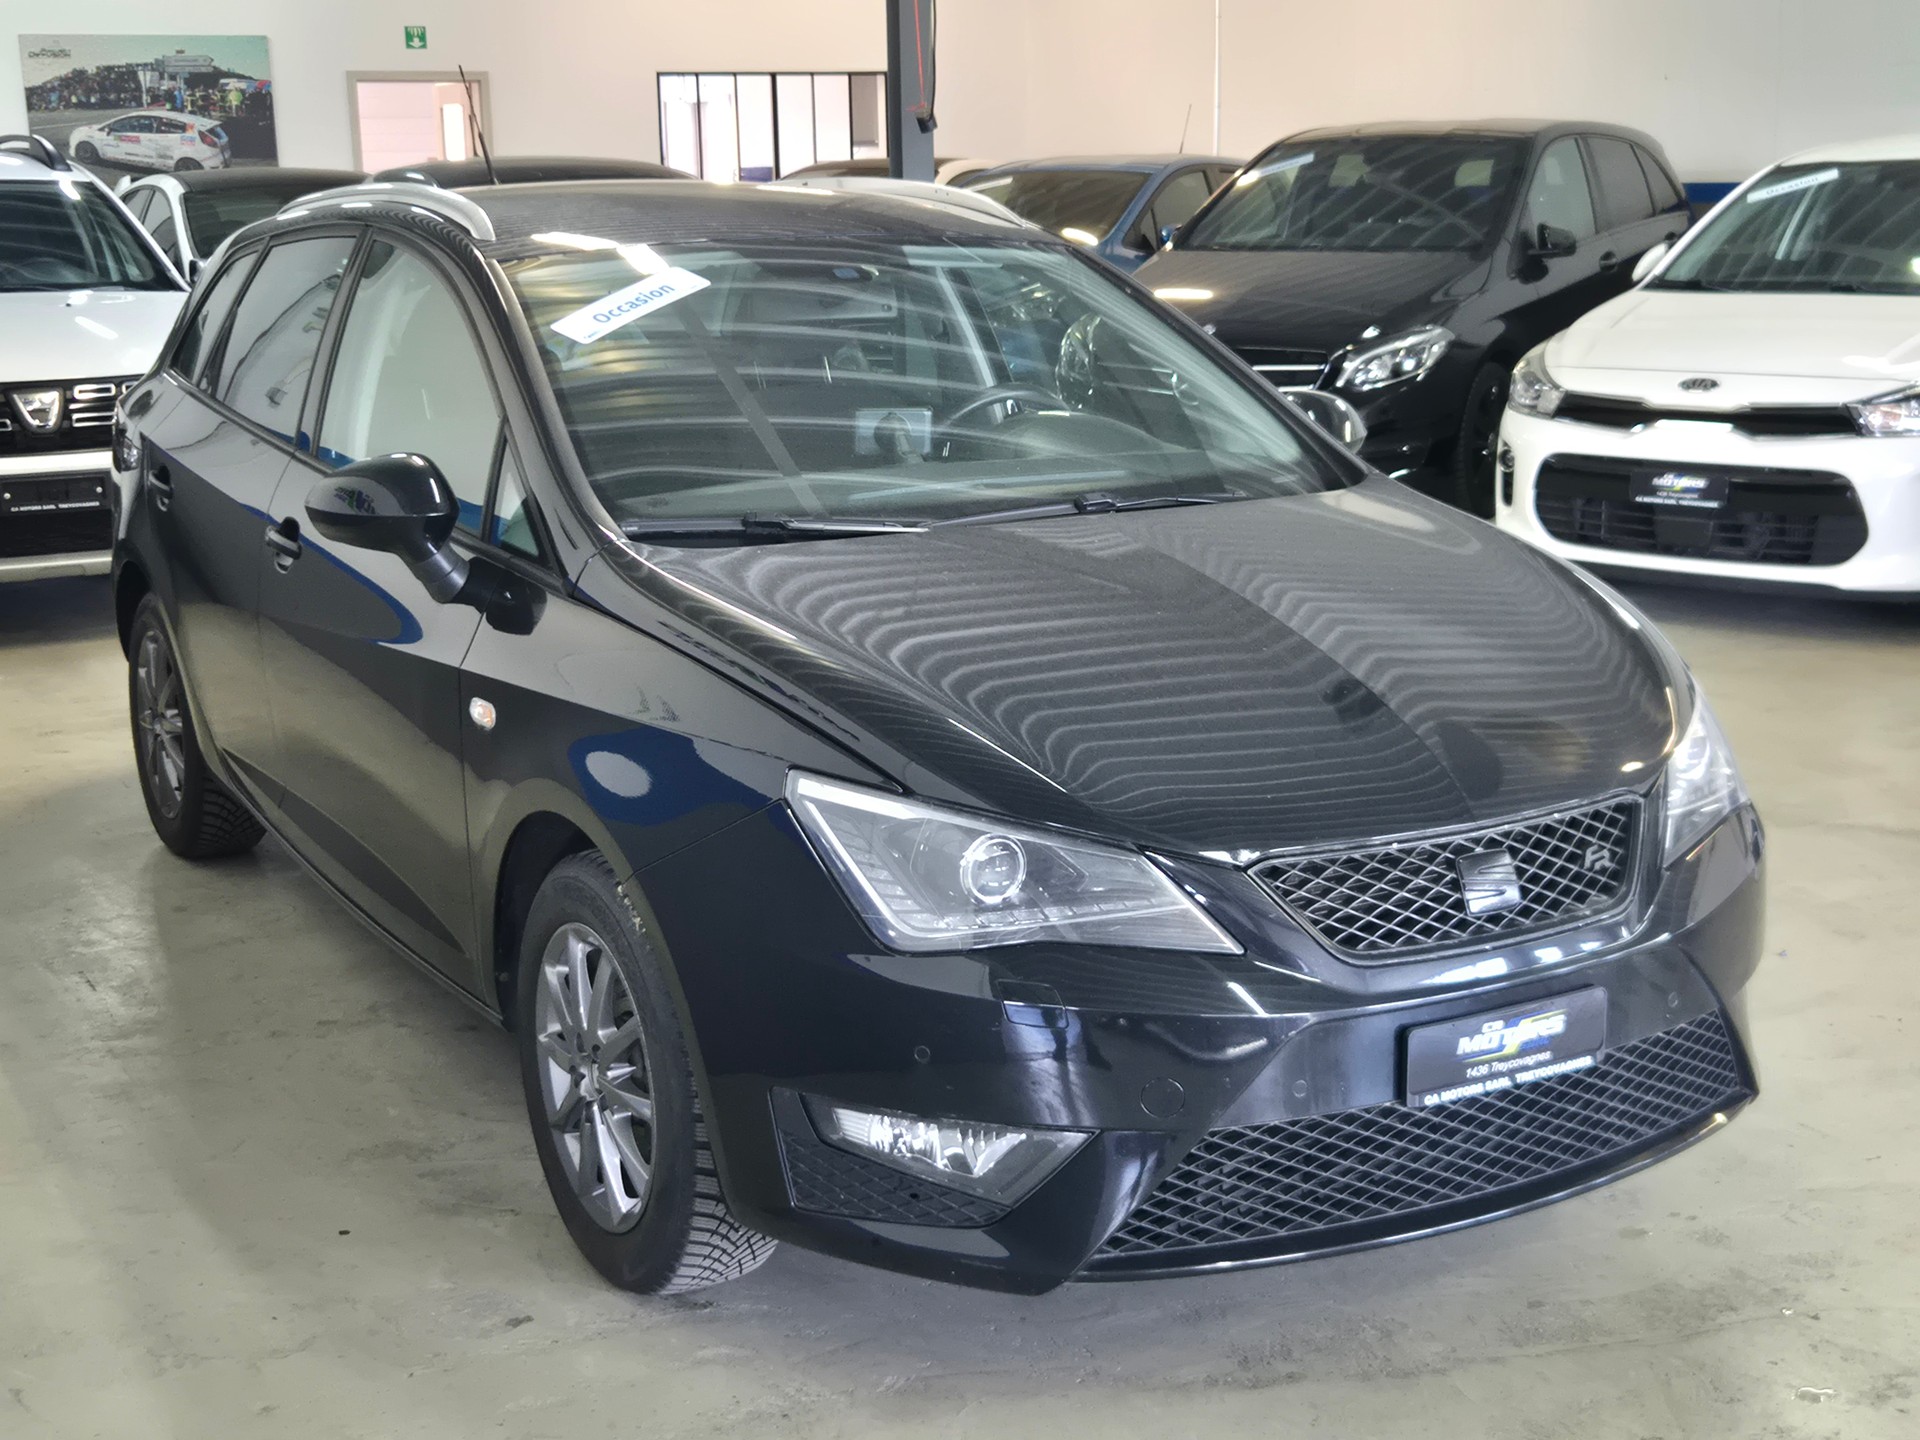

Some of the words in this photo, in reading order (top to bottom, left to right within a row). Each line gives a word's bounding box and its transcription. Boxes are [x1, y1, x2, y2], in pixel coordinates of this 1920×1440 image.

[592, 283, 676, 324] Occasion
[1456, 1014, 1568, 1056] MOTORS
[1424, 1093, 1440, 1107] CA
[1440, 1082, 1485, 1102] MOTORS
[1485, 1075, 1513, 1093] SARL
[1514, 1055, 1595, 1084] TREYCOVAGNES
[1466, 1064, 1489, 1079] 1436
[1491, 1051, 1552, 1073] Treycovagnes
